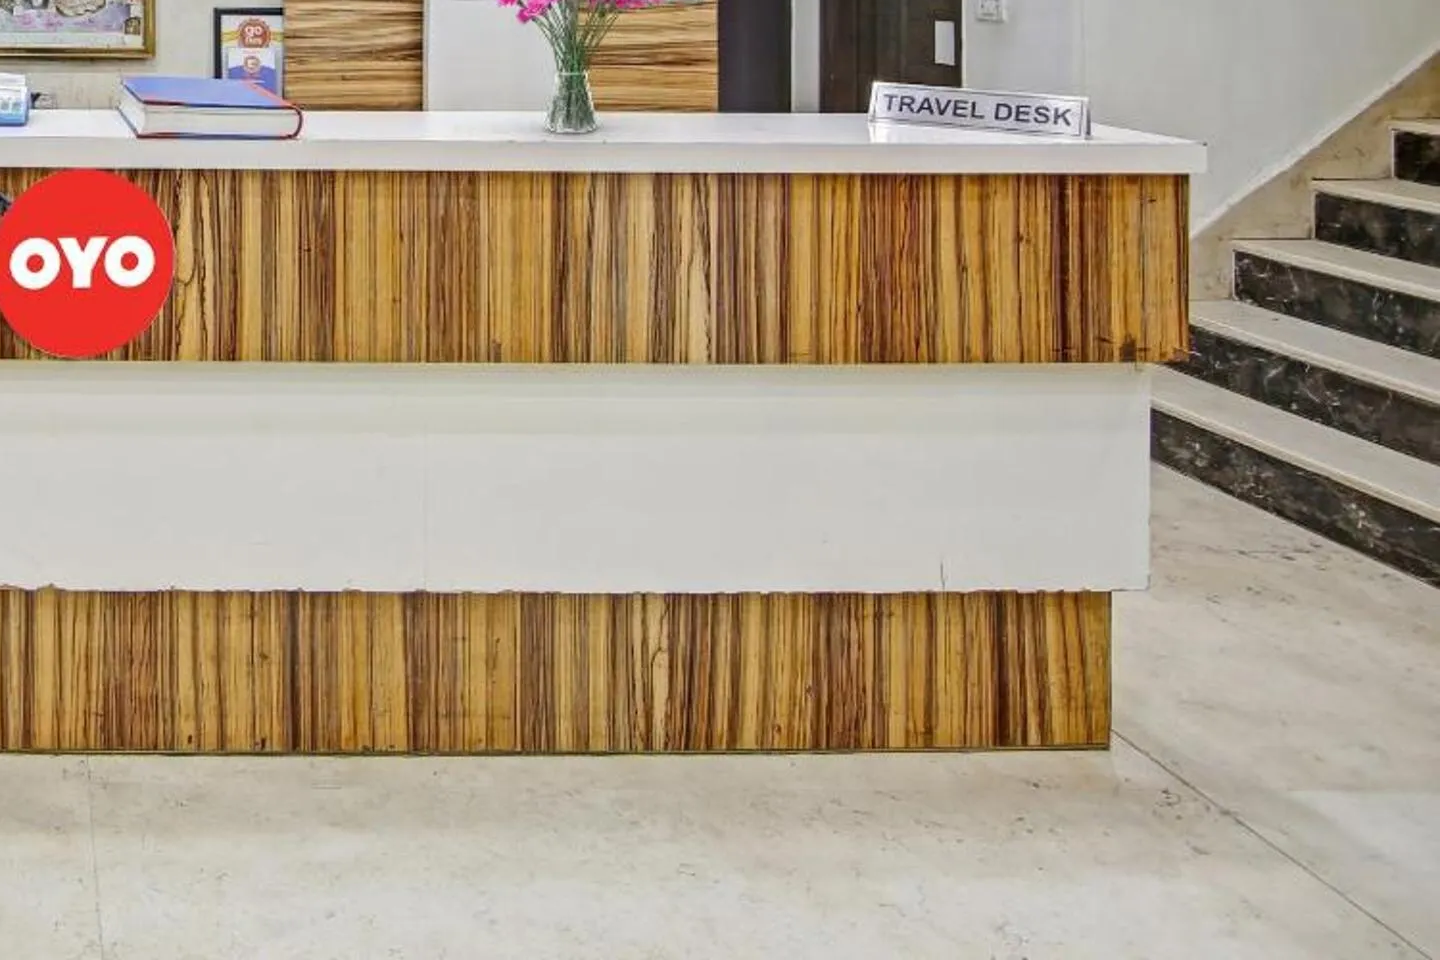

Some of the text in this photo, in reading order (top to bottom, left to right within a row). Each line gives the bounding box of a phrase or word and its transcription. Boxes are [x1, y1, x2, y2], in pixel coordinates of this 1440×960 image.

[884, 94, 1072, 126] TRAVEL DESK
[9, 235, 156, 290] OYO
